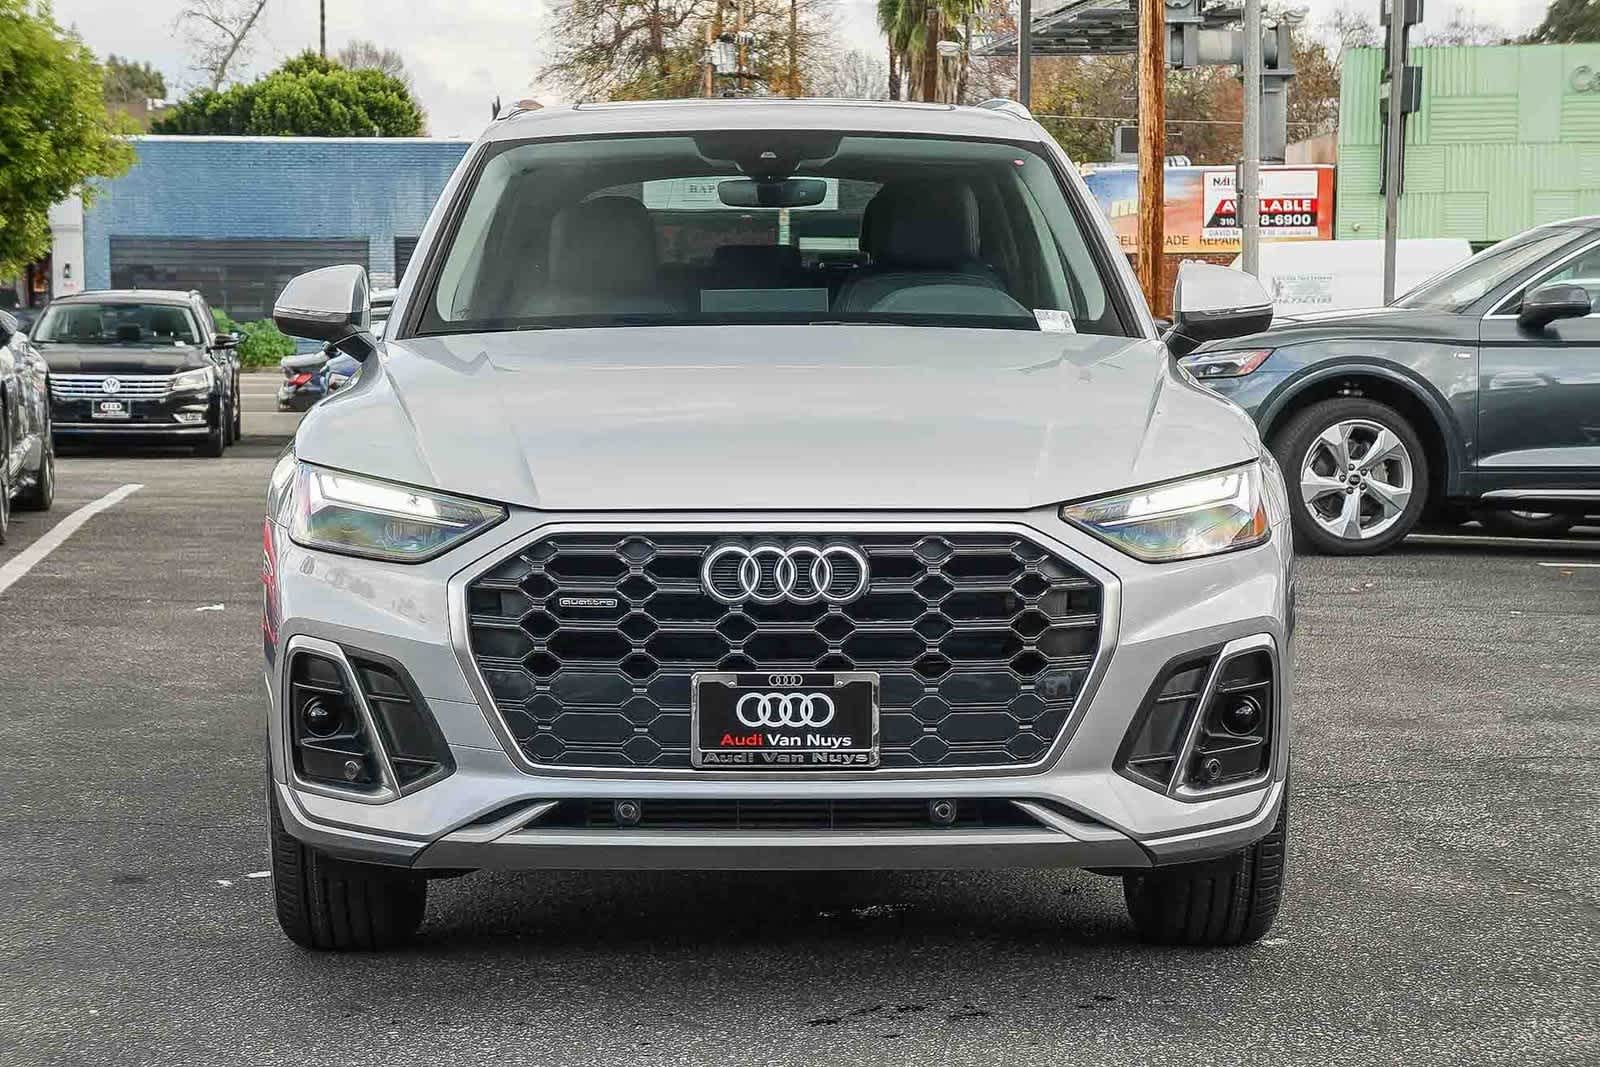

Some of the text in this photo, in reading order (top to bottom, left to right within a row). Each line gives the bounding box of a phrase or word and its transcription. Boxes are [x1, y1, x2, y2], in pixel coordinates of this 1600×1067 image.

[1221, 200, 1312, 211] ALABLE
[1116, 236, 1138, 246] ELL
[561, 599, 615, 607] quattro
[720, 733, 852, 749] Audi Van Nuys
[703, 751, 869, 765] Audi Van Nuys
